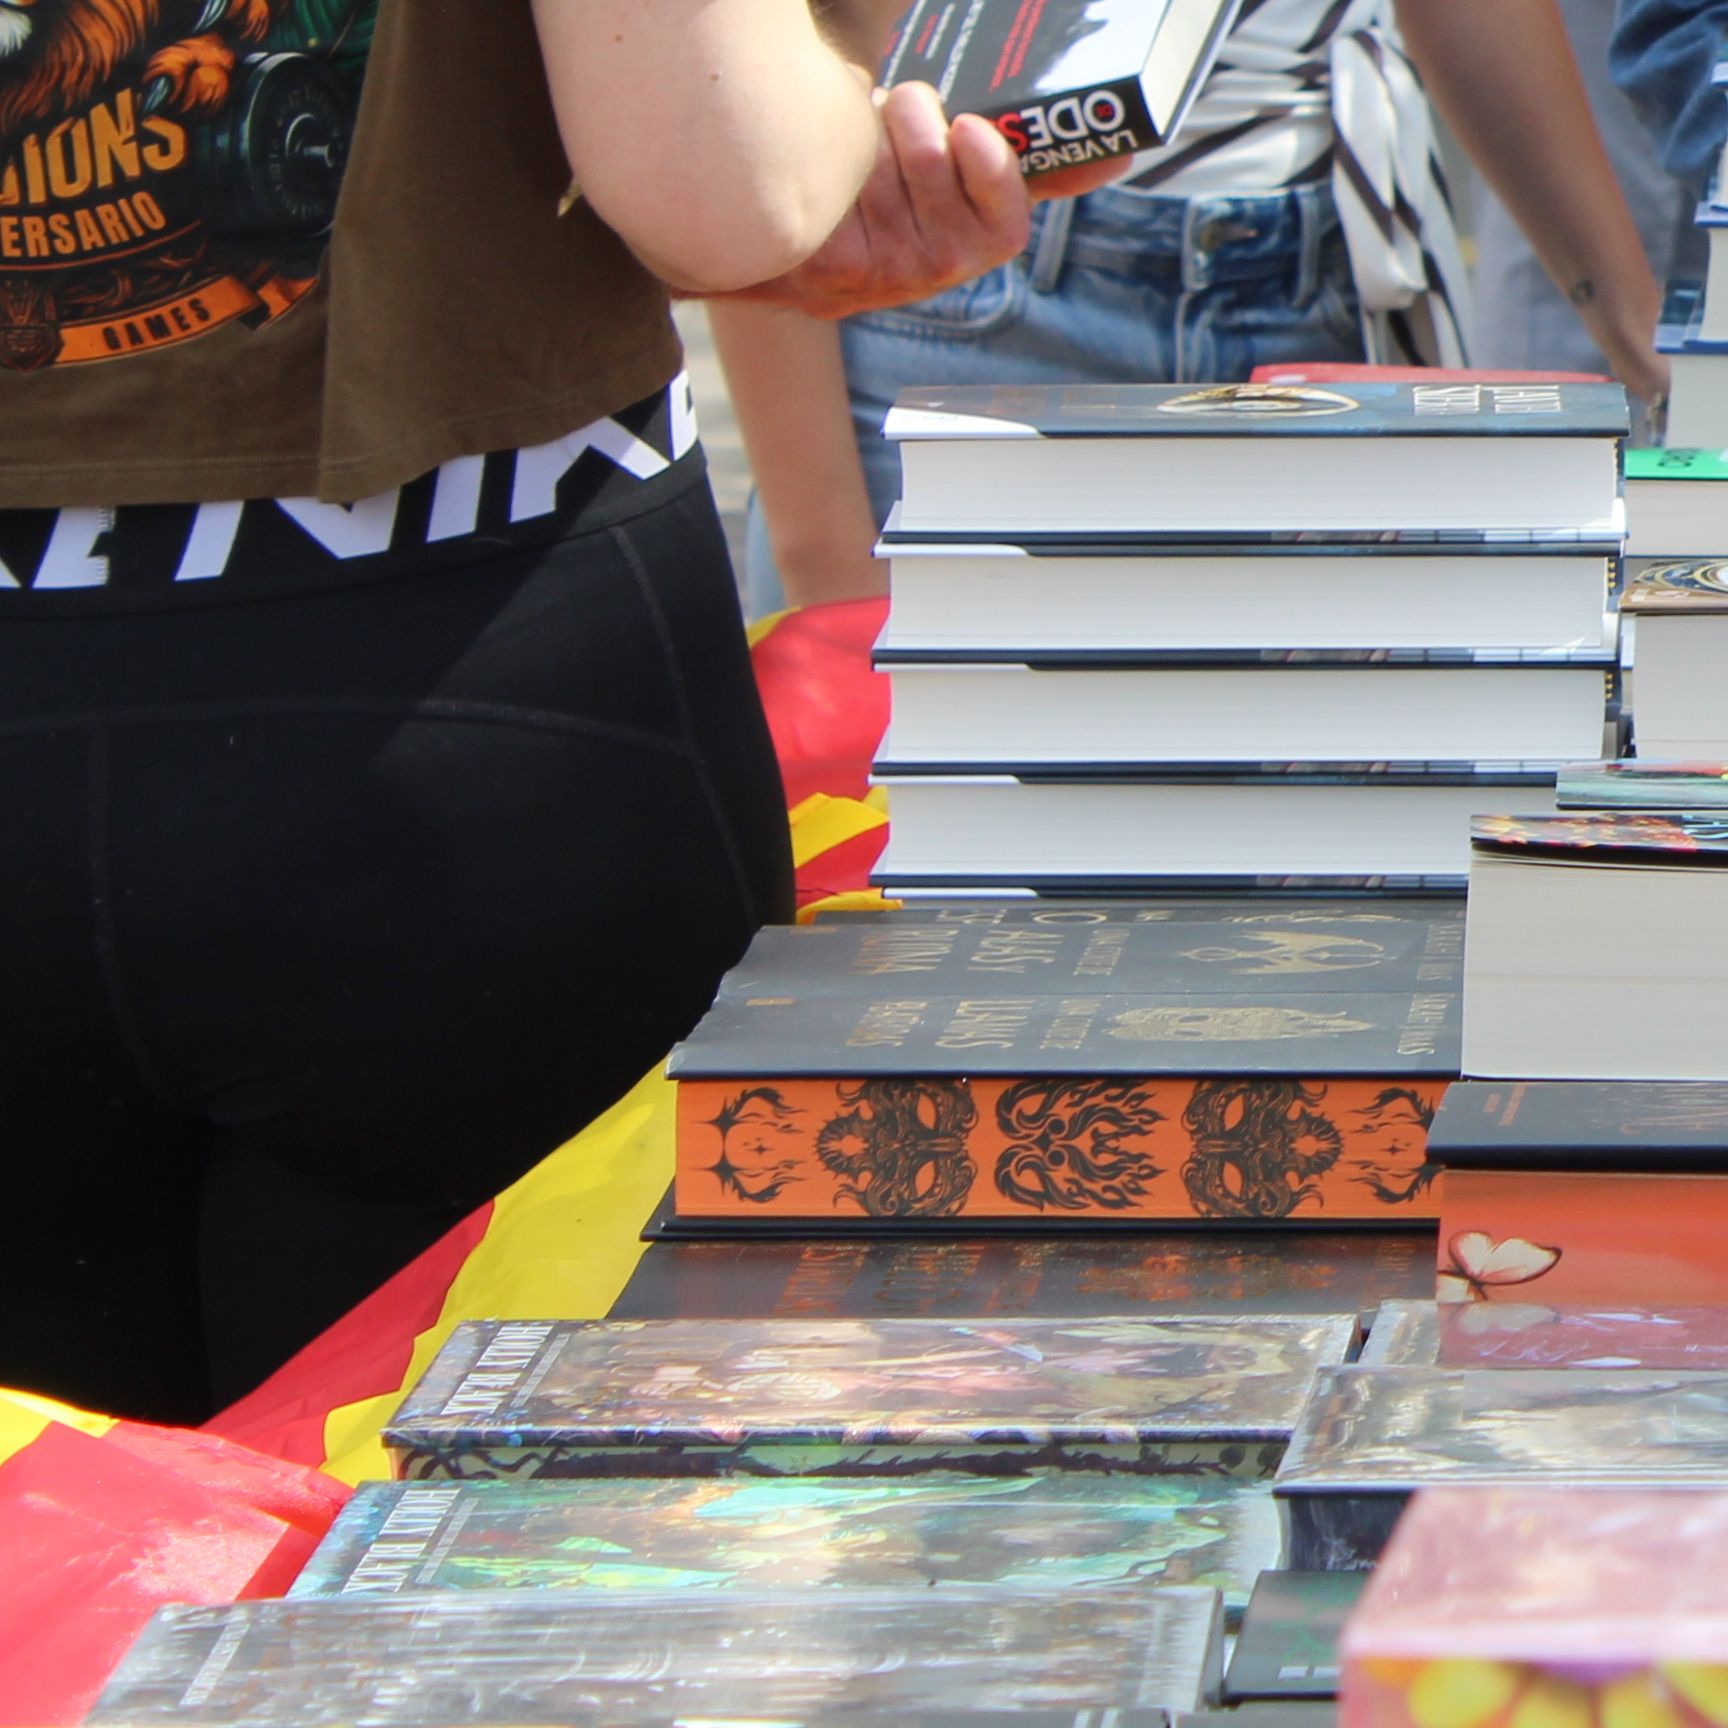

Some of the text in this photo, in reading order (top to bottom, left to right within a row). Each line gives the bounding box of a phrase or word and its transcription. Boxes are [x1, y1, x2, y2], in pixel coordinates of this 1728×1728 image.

[996, 89, 1126, 152] ODES
[1099, 128, 1138, 153] LA
[102, 297, 211, 352] GAMES
[852, 929, 959, 975] RUINA
[969, 930, 1065, 963] ALAS
[933, 998, 1034, 1049] LLAMAS
[476, 1324, 553, 1368] HOLLY
[440, 1370, 521, 1415] BLACK
[377, 1487, 460, 1536] HOLLY
[341, 1540, 427, 1593] BLACK
